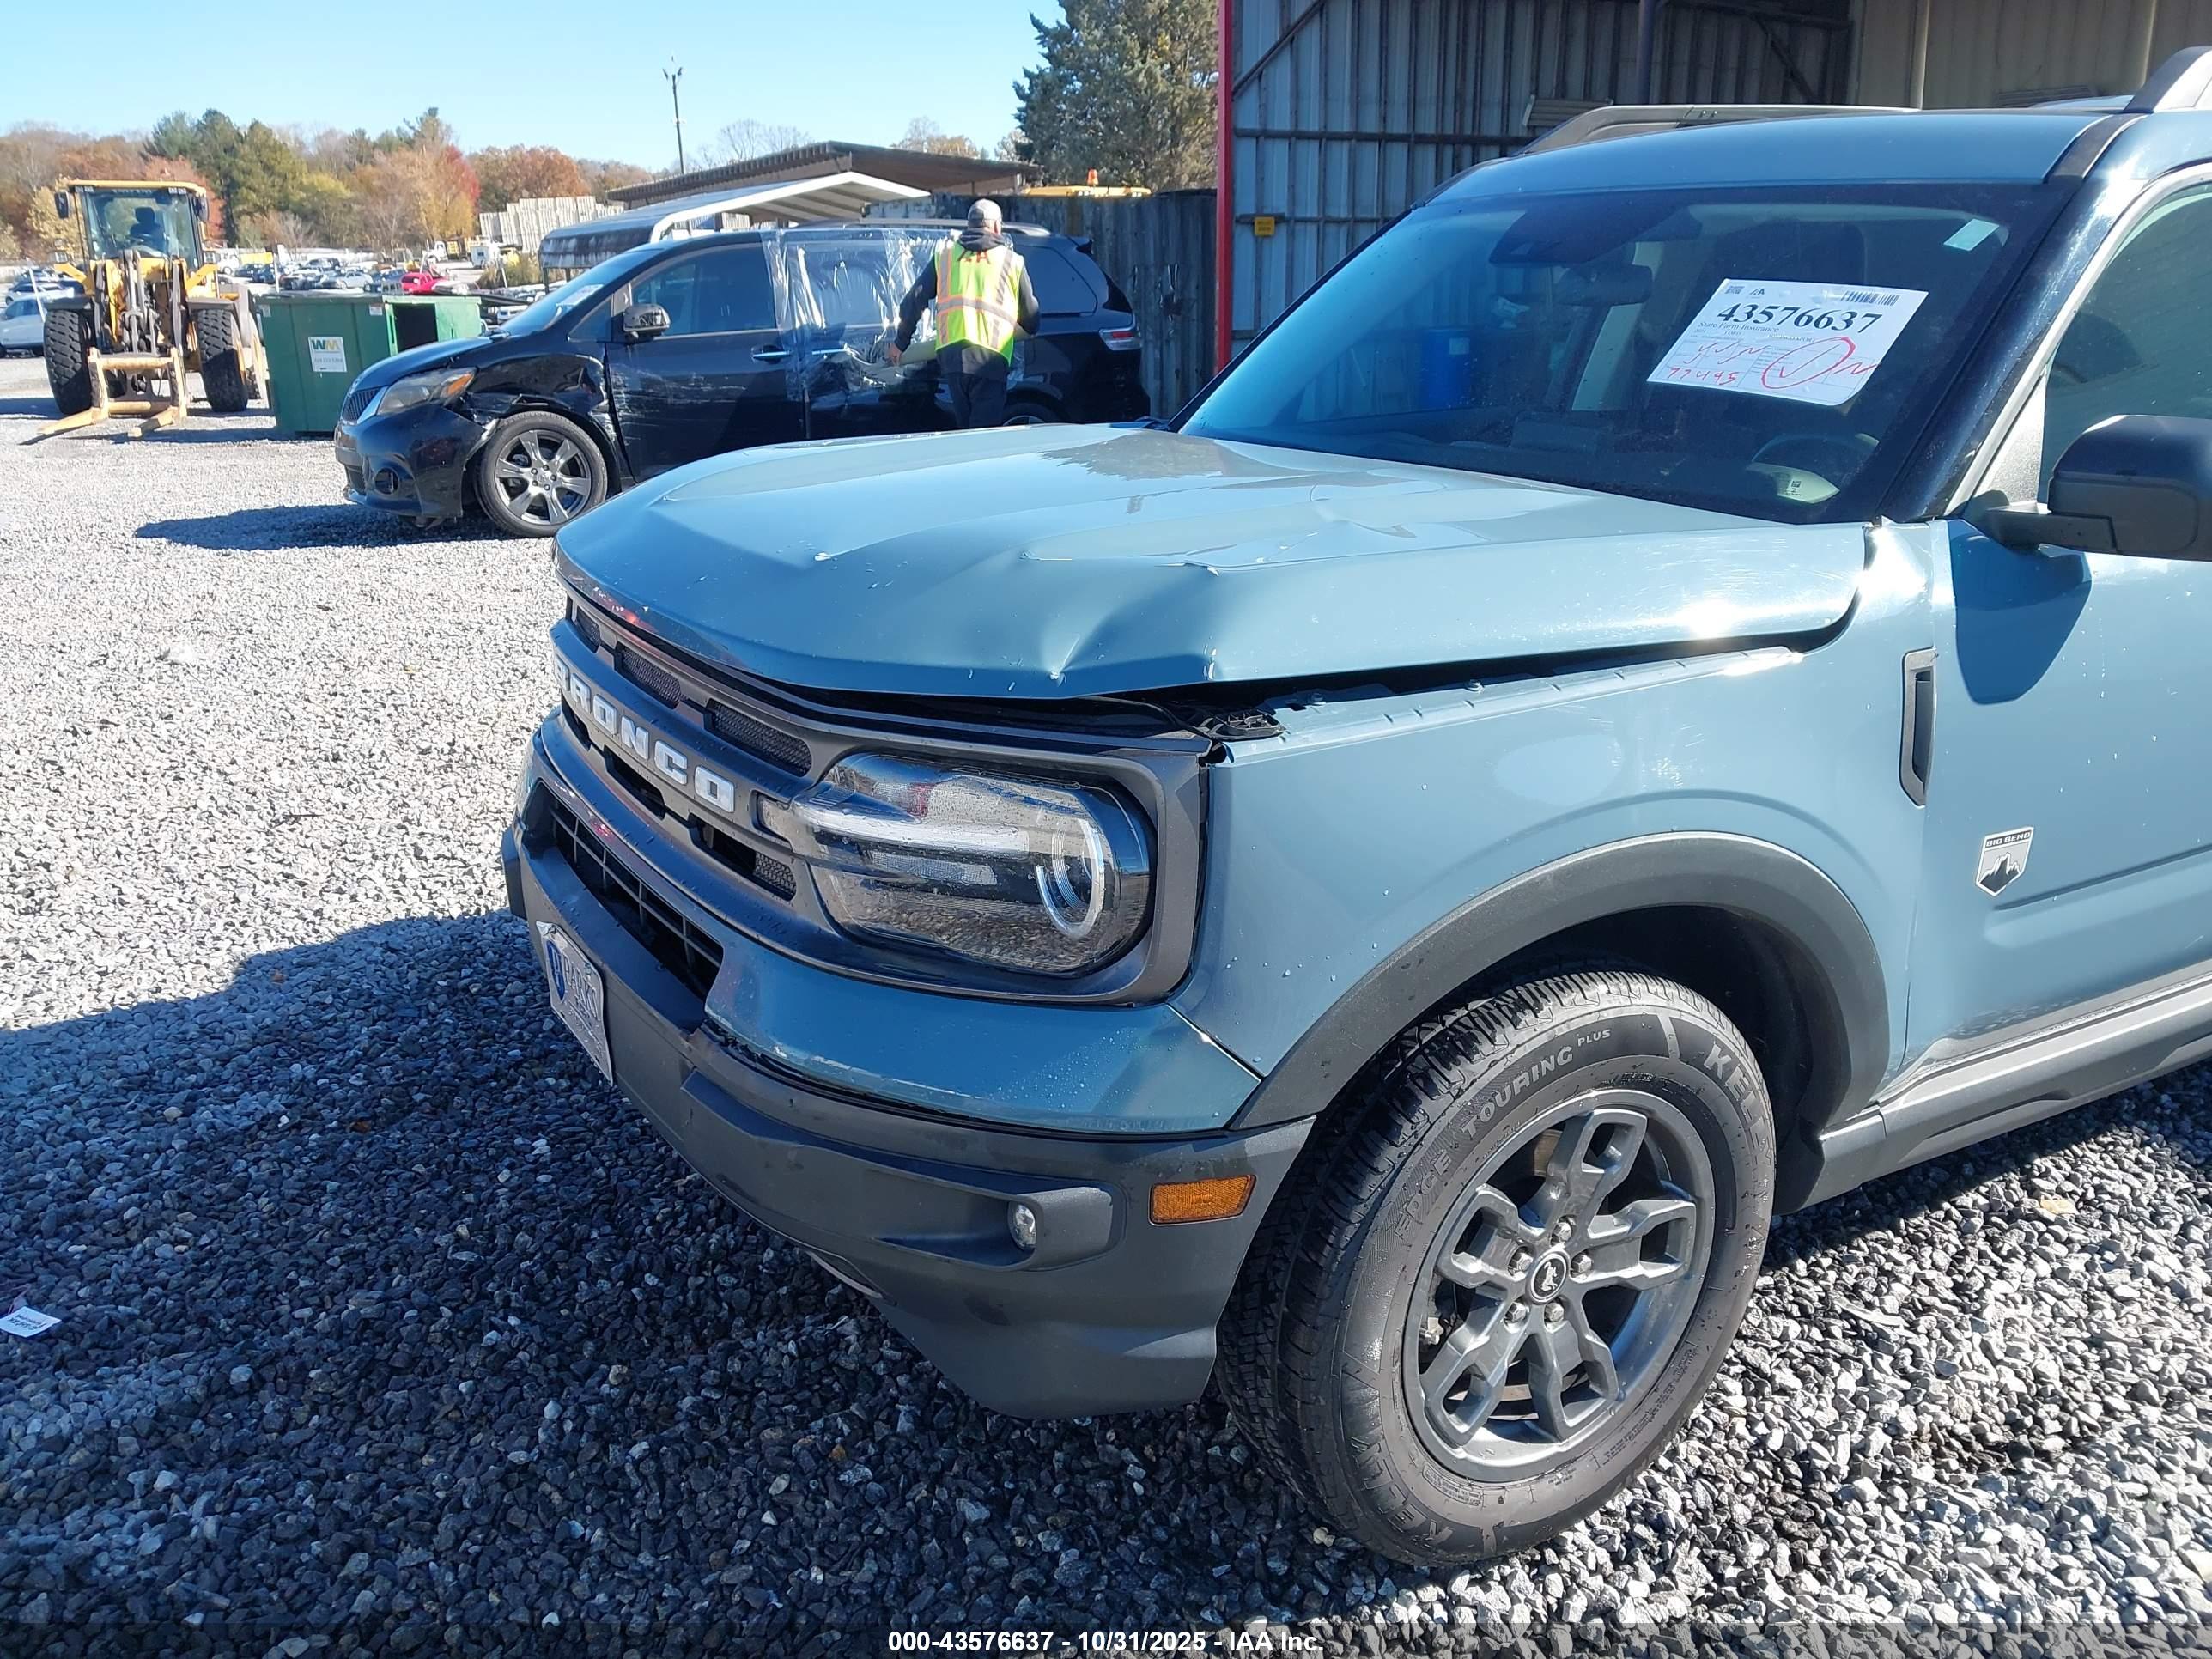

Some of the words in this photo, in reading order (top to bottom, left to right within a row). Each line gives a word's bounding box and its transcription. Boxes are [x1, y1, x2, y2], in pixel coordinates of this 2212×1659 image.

[1717, 302, 1882, 333] 43576637
[1741, 324, 1780, 332] Insurance
[311, 339, 341, 350] WM
[1985, 837, 2002, 848] BIG
[2003, 831, 2031, 843] BEND
[1393, 1149, 1453, 1237] EDGE
[1462, 1045, 1574, 1139] TOURING
[1577, 1030, 1612, 1048] PLUS
